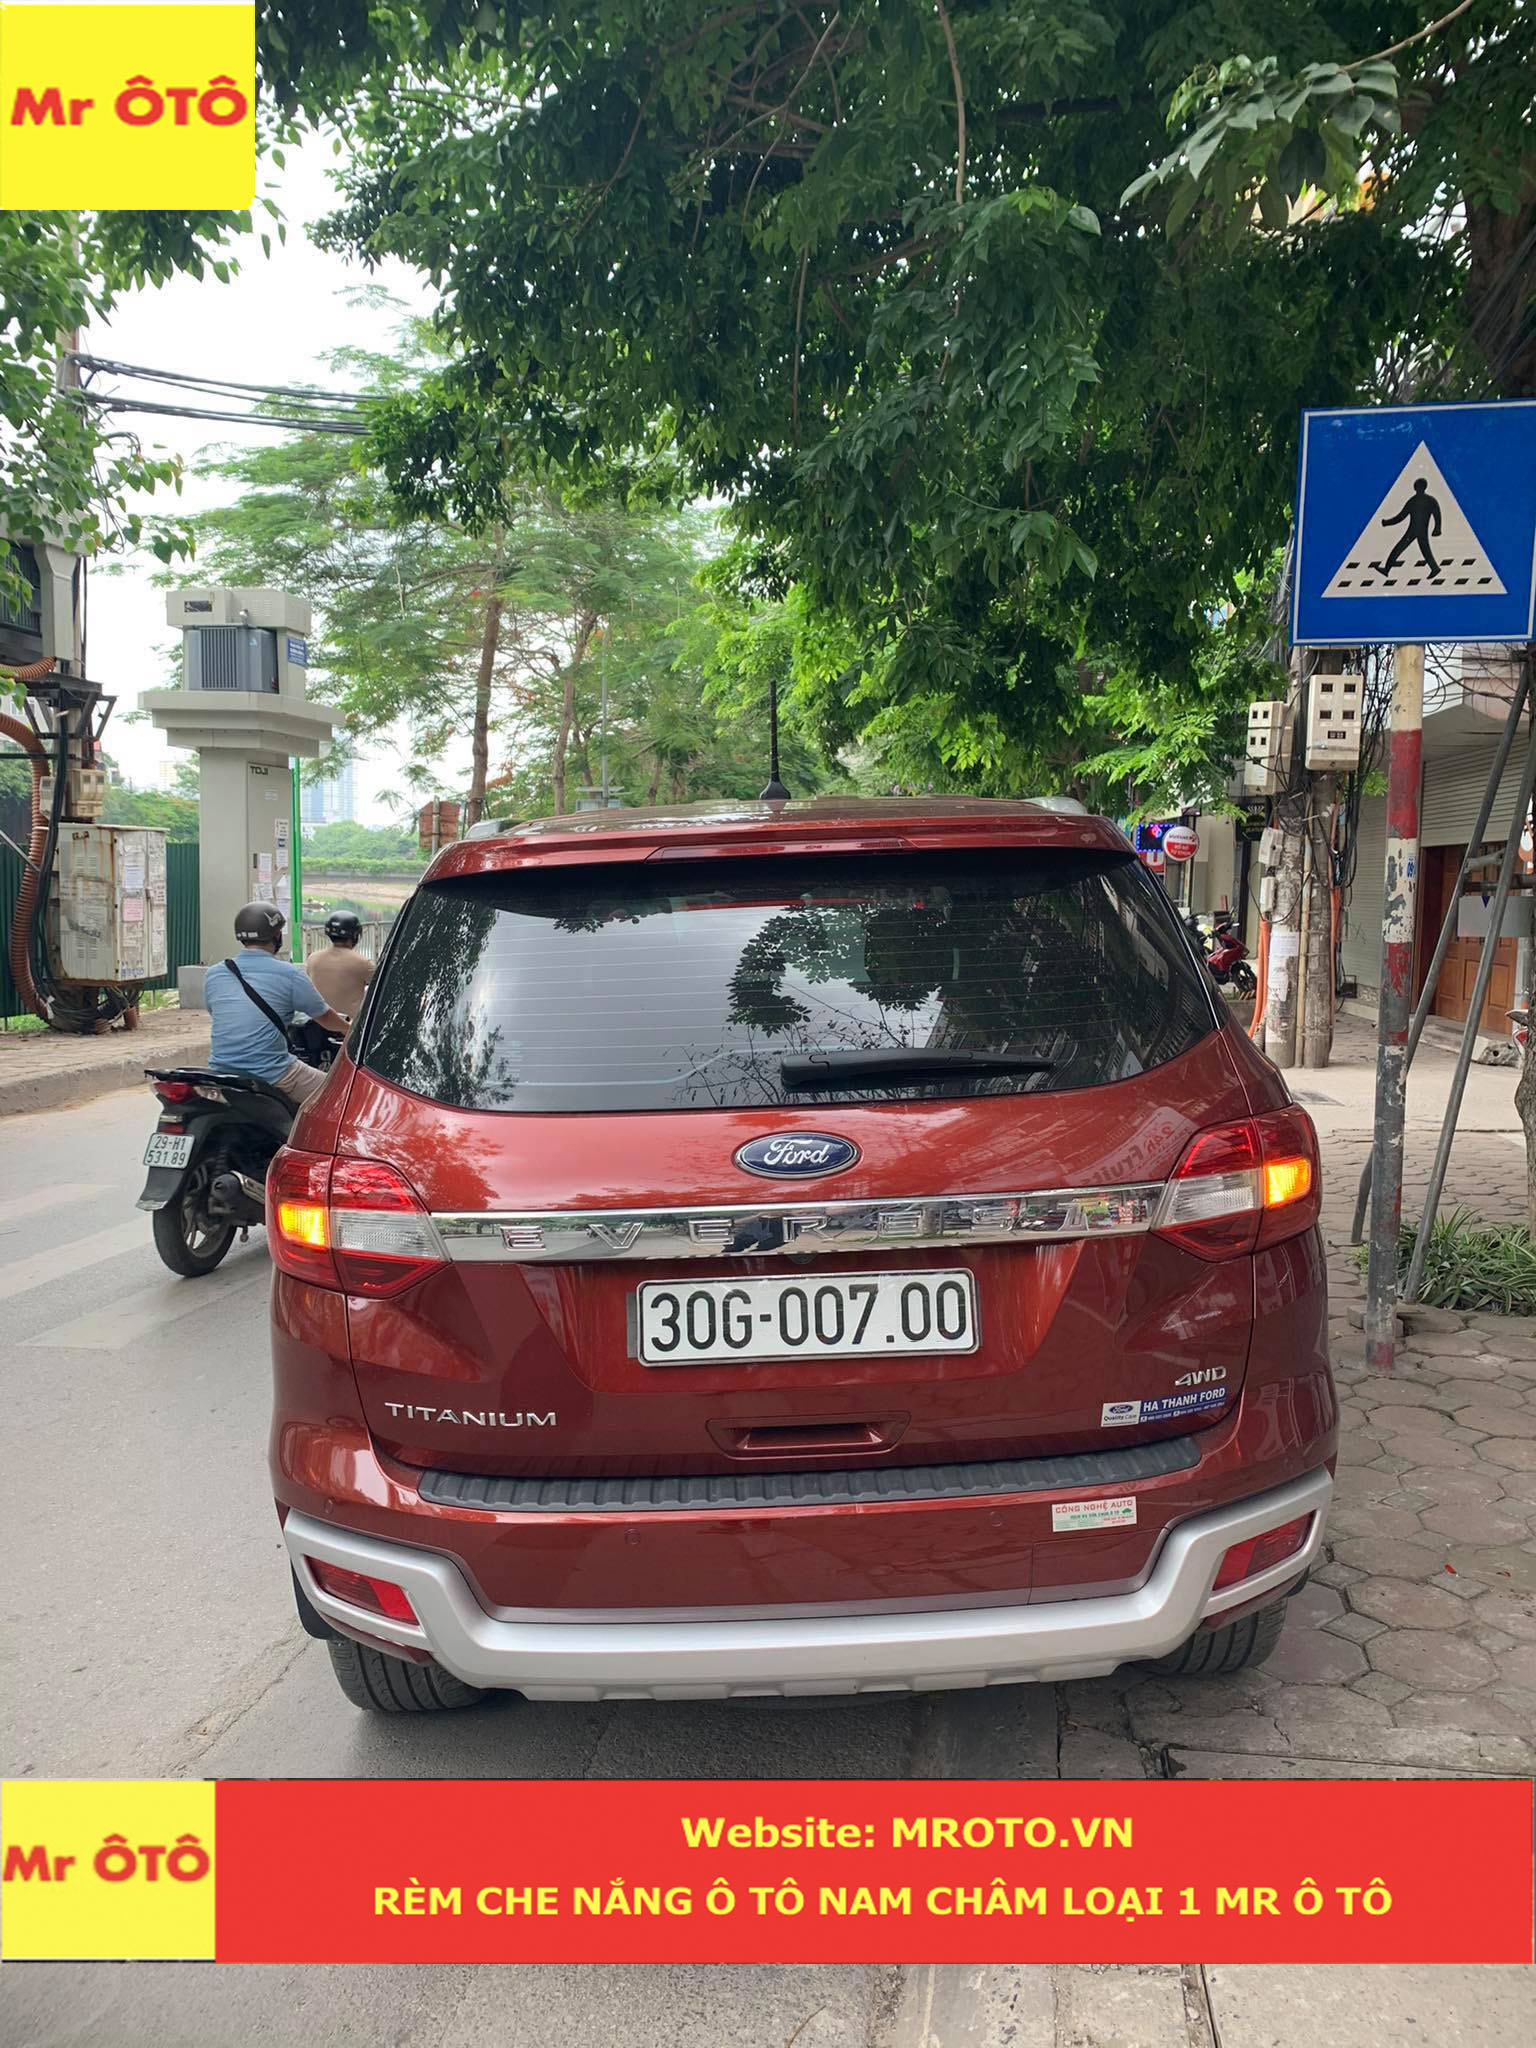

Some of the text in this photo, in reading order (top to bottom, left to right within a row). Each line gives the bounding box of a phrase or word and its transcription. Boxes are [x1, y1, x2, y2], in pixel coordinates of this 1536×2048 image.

[154, 1136, 187, 1151] 29-H1
[763, 1138, 831, 1166] Ford
[147, 1150, 186, 1166] 531.89
[499, 1203, 1090, 1252] EVEREST
[650, 1280, 966, 1352] 30G-007.00
[1175, 1365, 1227, 1386] 4WD
[1143, 1401, 1159, 1412] HA
[1161, 1394, 1198, 1408] THANH
[1199, 1387, 1226, 1402] FORD
[384, 1402, 558, 1427] TITANIUM
[1111, 1499, 1133, 1508] AUTO
